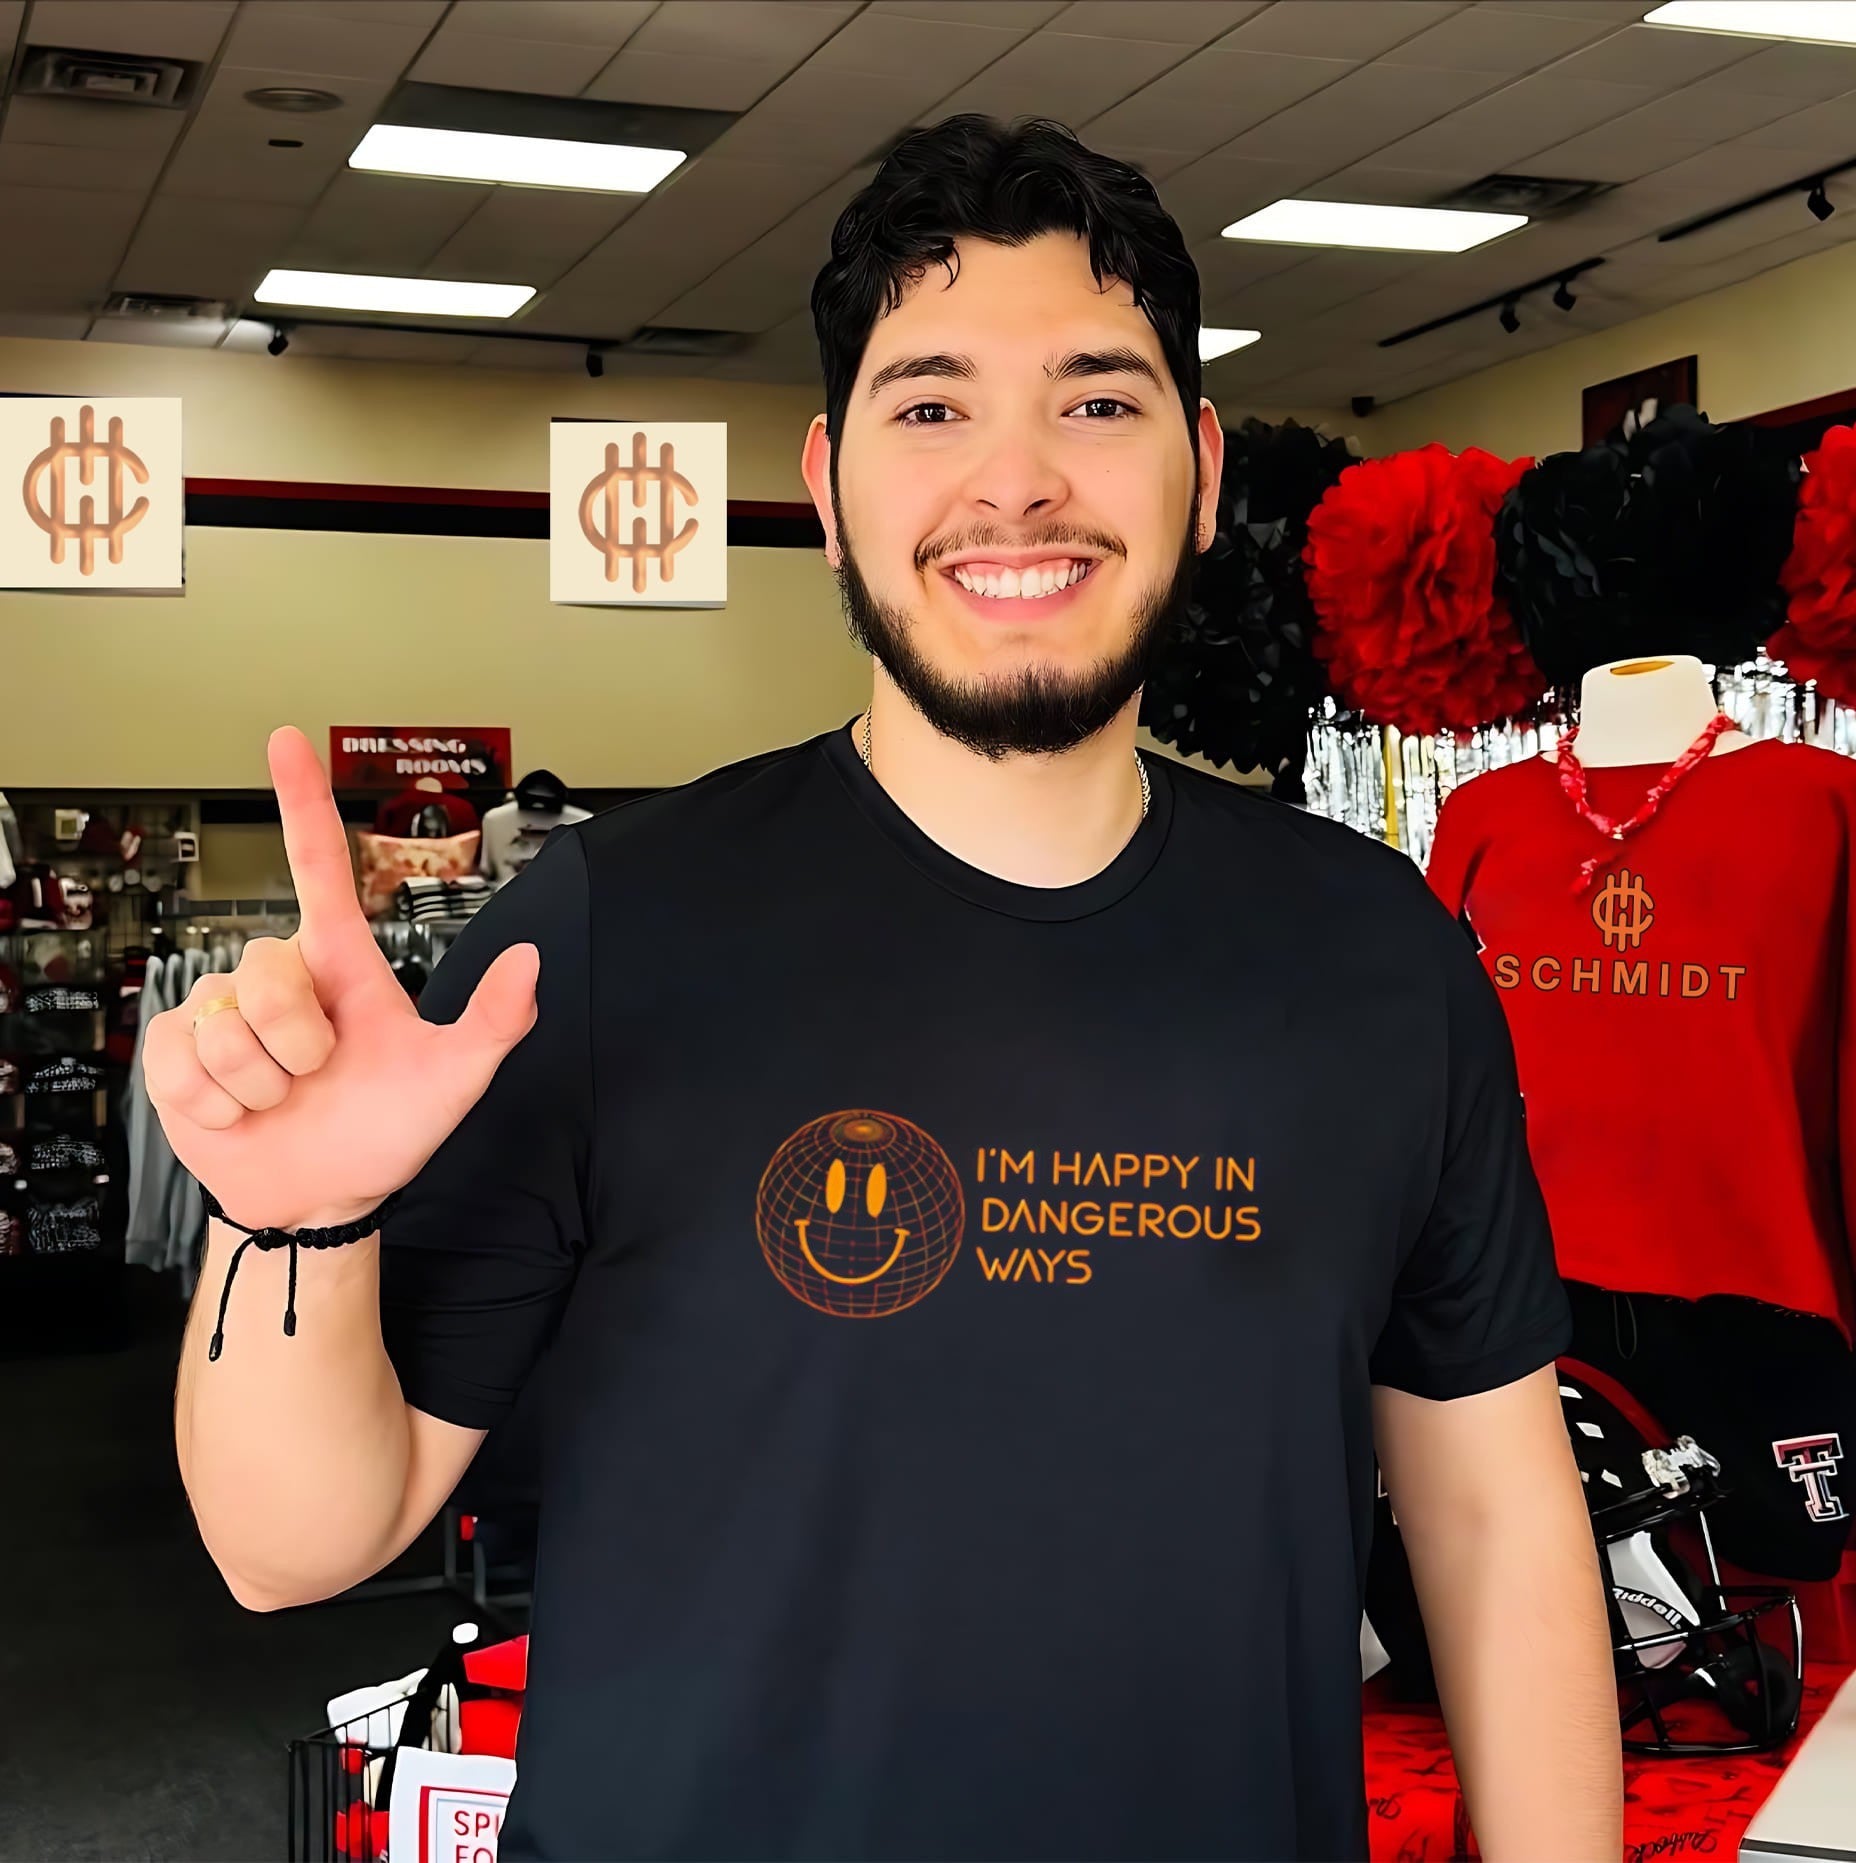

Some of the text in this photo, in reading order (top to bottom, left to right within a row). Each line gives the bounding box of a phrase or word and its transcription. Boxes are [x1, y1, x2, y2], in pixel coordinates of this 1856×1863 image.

[396, 758, 487, 775] ROOMS
[1494, 953, 1746, 1000] SCHMIDT
[977, 1147, 1256, 1192] I'M HAPPY IN
[981, 1197, 1263, 1241] DANGEROUS
[976, 1246, 1093, 1285] WAYS
